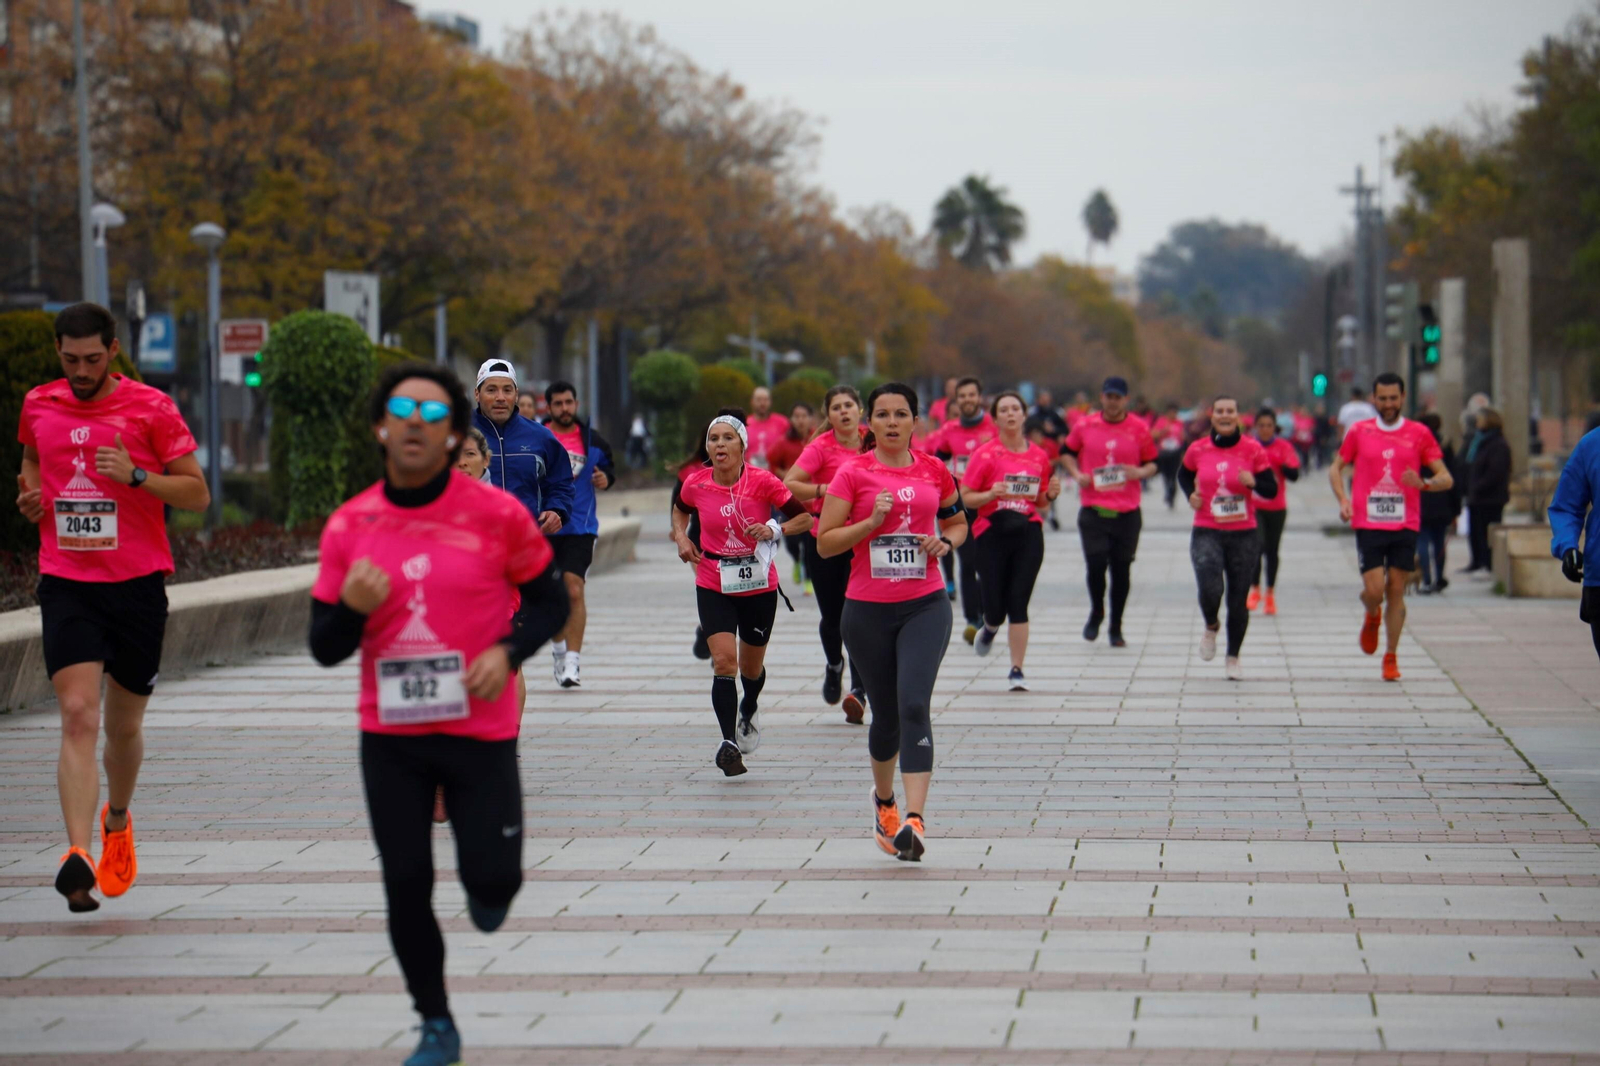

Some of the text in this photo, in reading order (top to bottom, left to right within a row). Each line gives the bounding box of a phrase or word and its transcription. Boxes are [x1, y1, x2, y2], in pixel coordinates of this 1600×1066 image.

[141, 319, 166, 351] P
[66, 516, 101, 533] 2043
[886, 549, 914, 563] 1311
[738, 566, 753, 579] 43
[401, 678, 438, 700] 602
